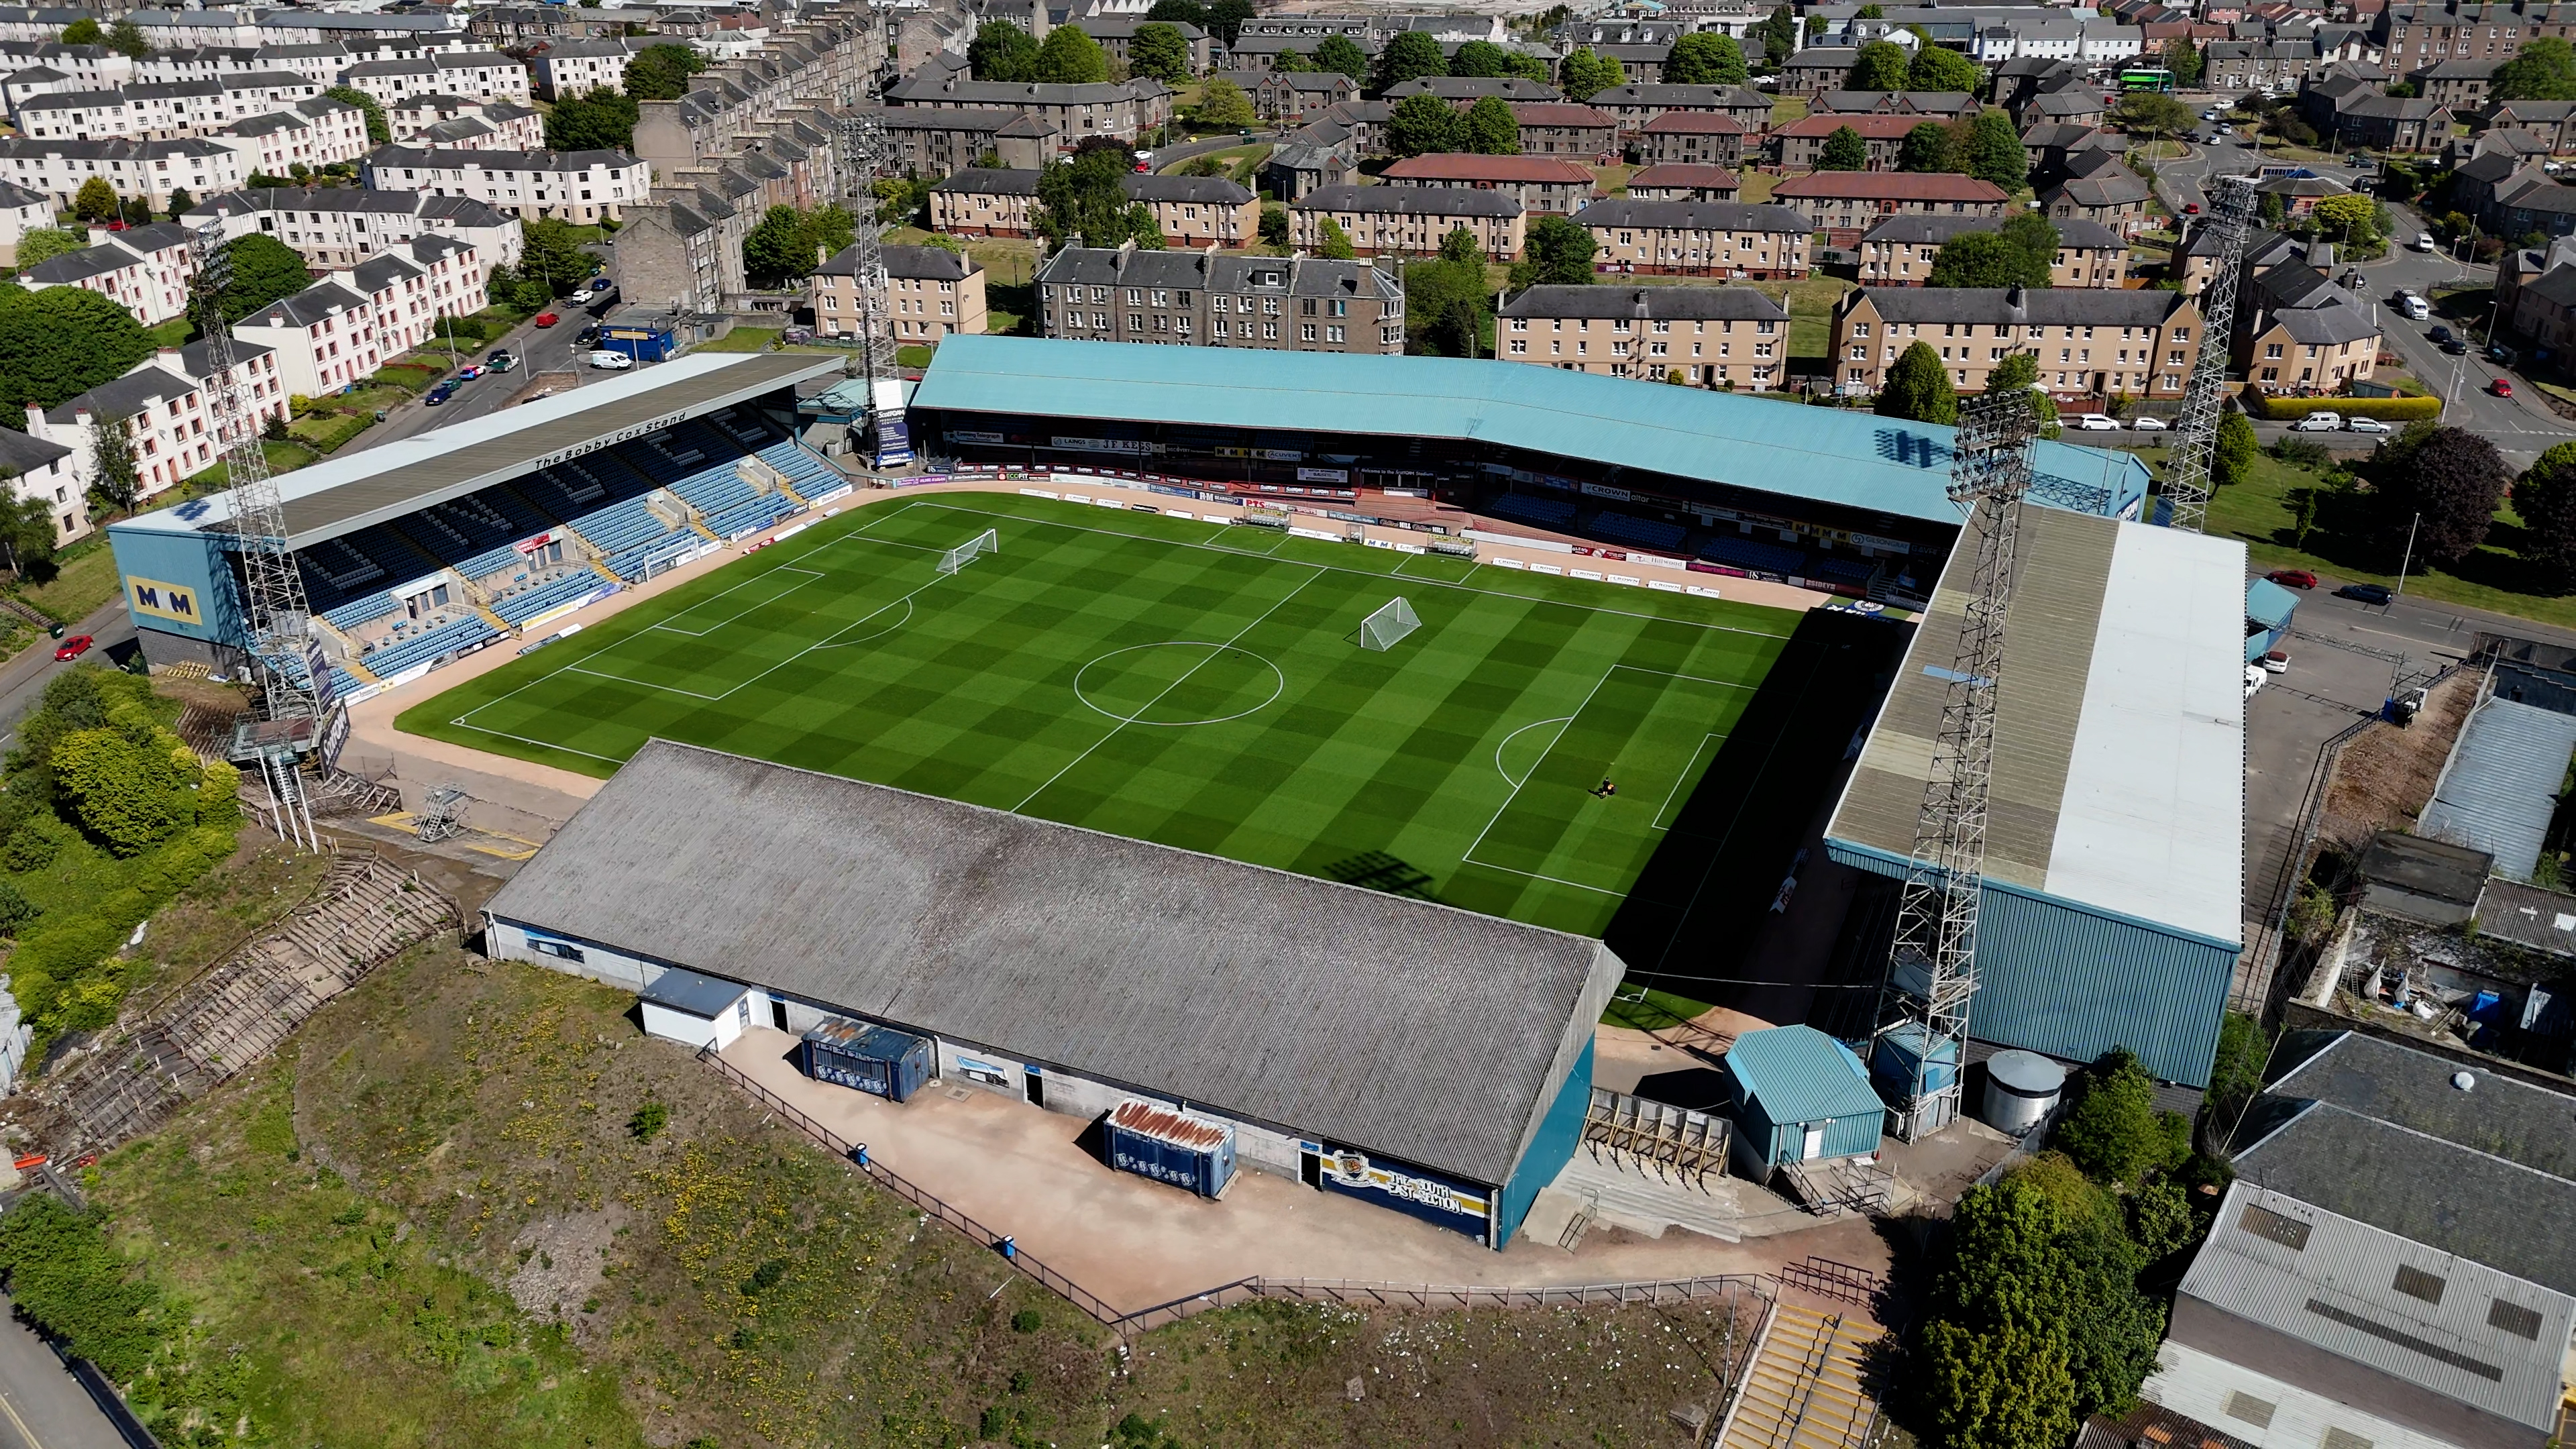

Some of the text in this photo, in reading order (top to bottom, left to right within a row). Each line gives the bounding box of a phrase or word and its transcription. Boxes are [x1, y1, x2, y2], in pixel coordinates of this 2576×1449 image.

[535, 411, 687, 470] The Bobby Cox Stand
[1592, 486, 1628, 497] CROWN
[1246, 498, 1265, 509] PTS
[1651, 557, 1682, 568] Hillwood
[1387, 1181, 1414, 1201] EAST
[1388, 1171, 1451, 1198] THE SOUTH
